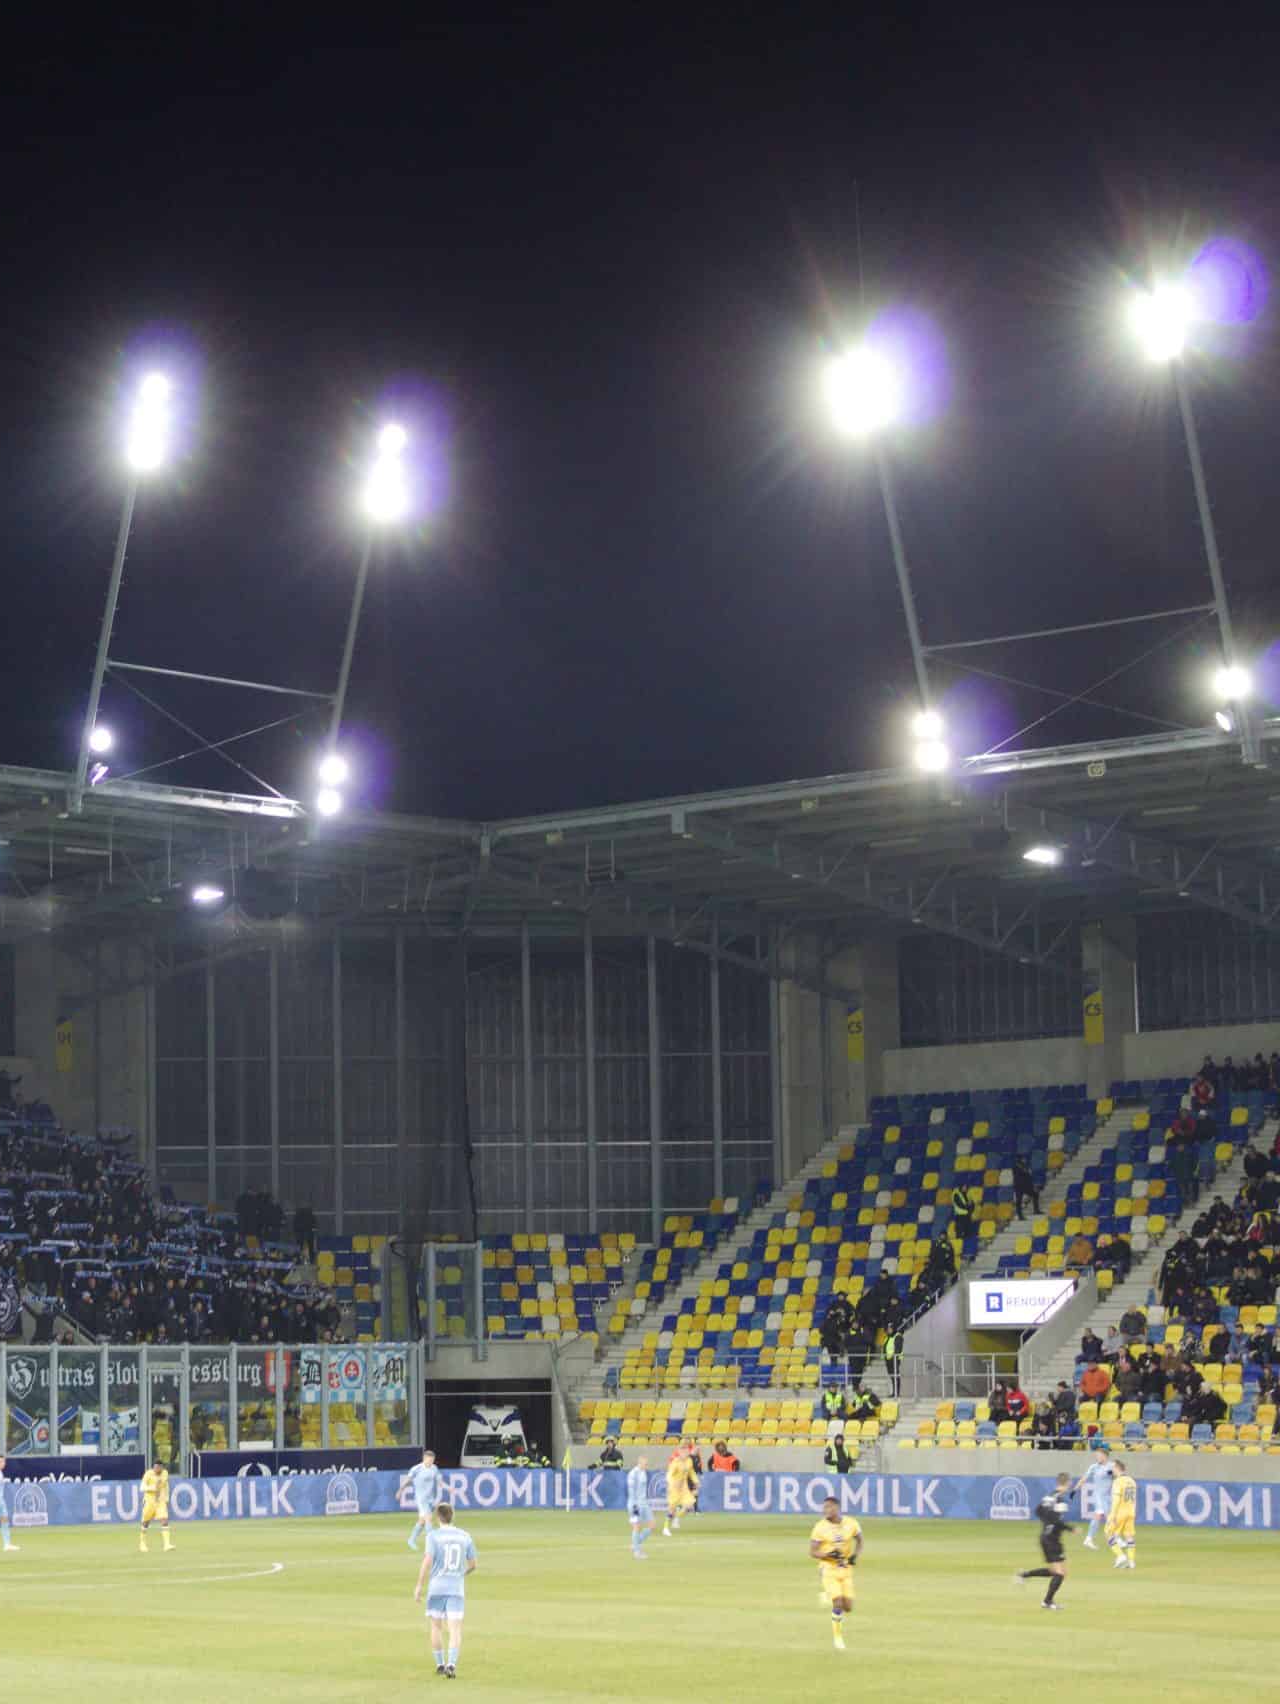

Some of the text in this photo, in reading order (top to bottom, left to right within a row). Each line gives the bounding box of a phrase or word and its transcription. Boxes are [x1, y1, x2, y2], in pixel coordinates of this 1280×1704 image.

[91, 1478, 295, 1522] EUOMILK
[723, 1474, 943, 1516] EUROMILK
[1080, 1483, 1272, 1528] EROMI
[443, 1543, 461, 1572] 10
